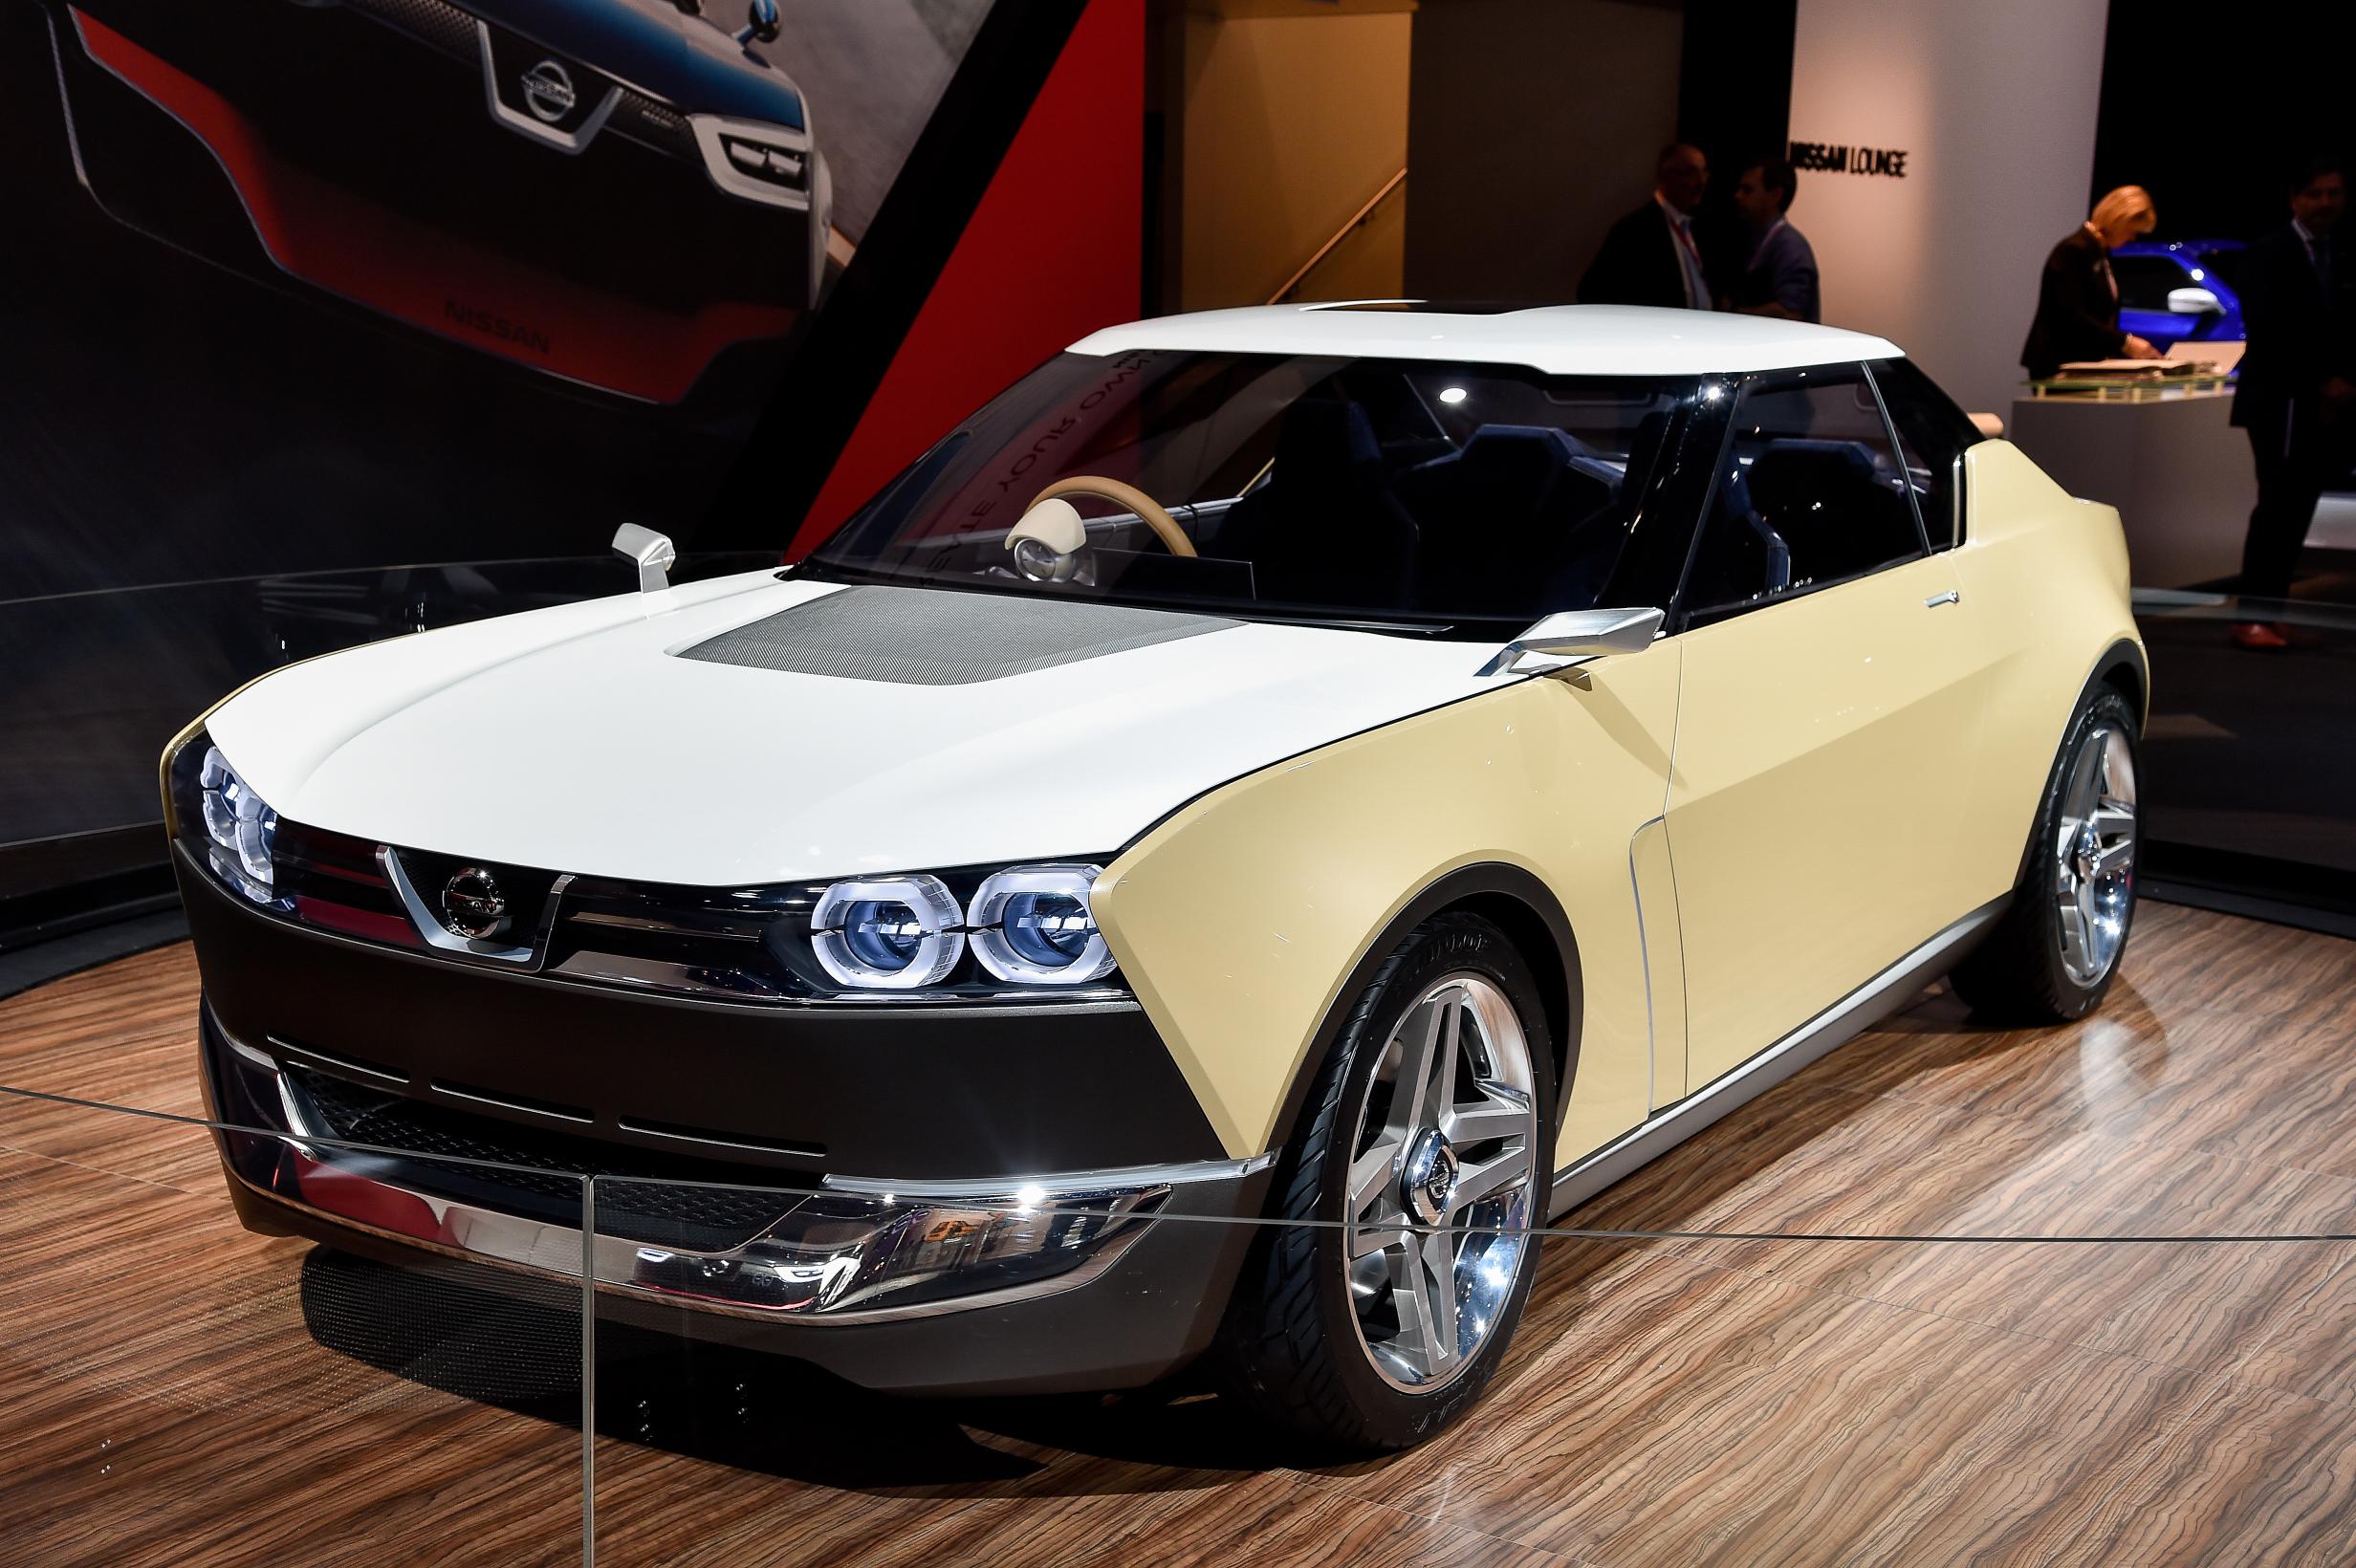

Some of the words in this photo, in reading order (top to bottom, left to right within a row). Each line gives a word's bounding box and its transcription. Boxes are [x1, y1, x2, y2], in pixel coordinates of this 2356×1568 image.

[1791, 142, 1846, 172] NISSAN
[1850, 146, 1908, 178] LOUNGE
[444, 299, 551, 355] NISSAN
